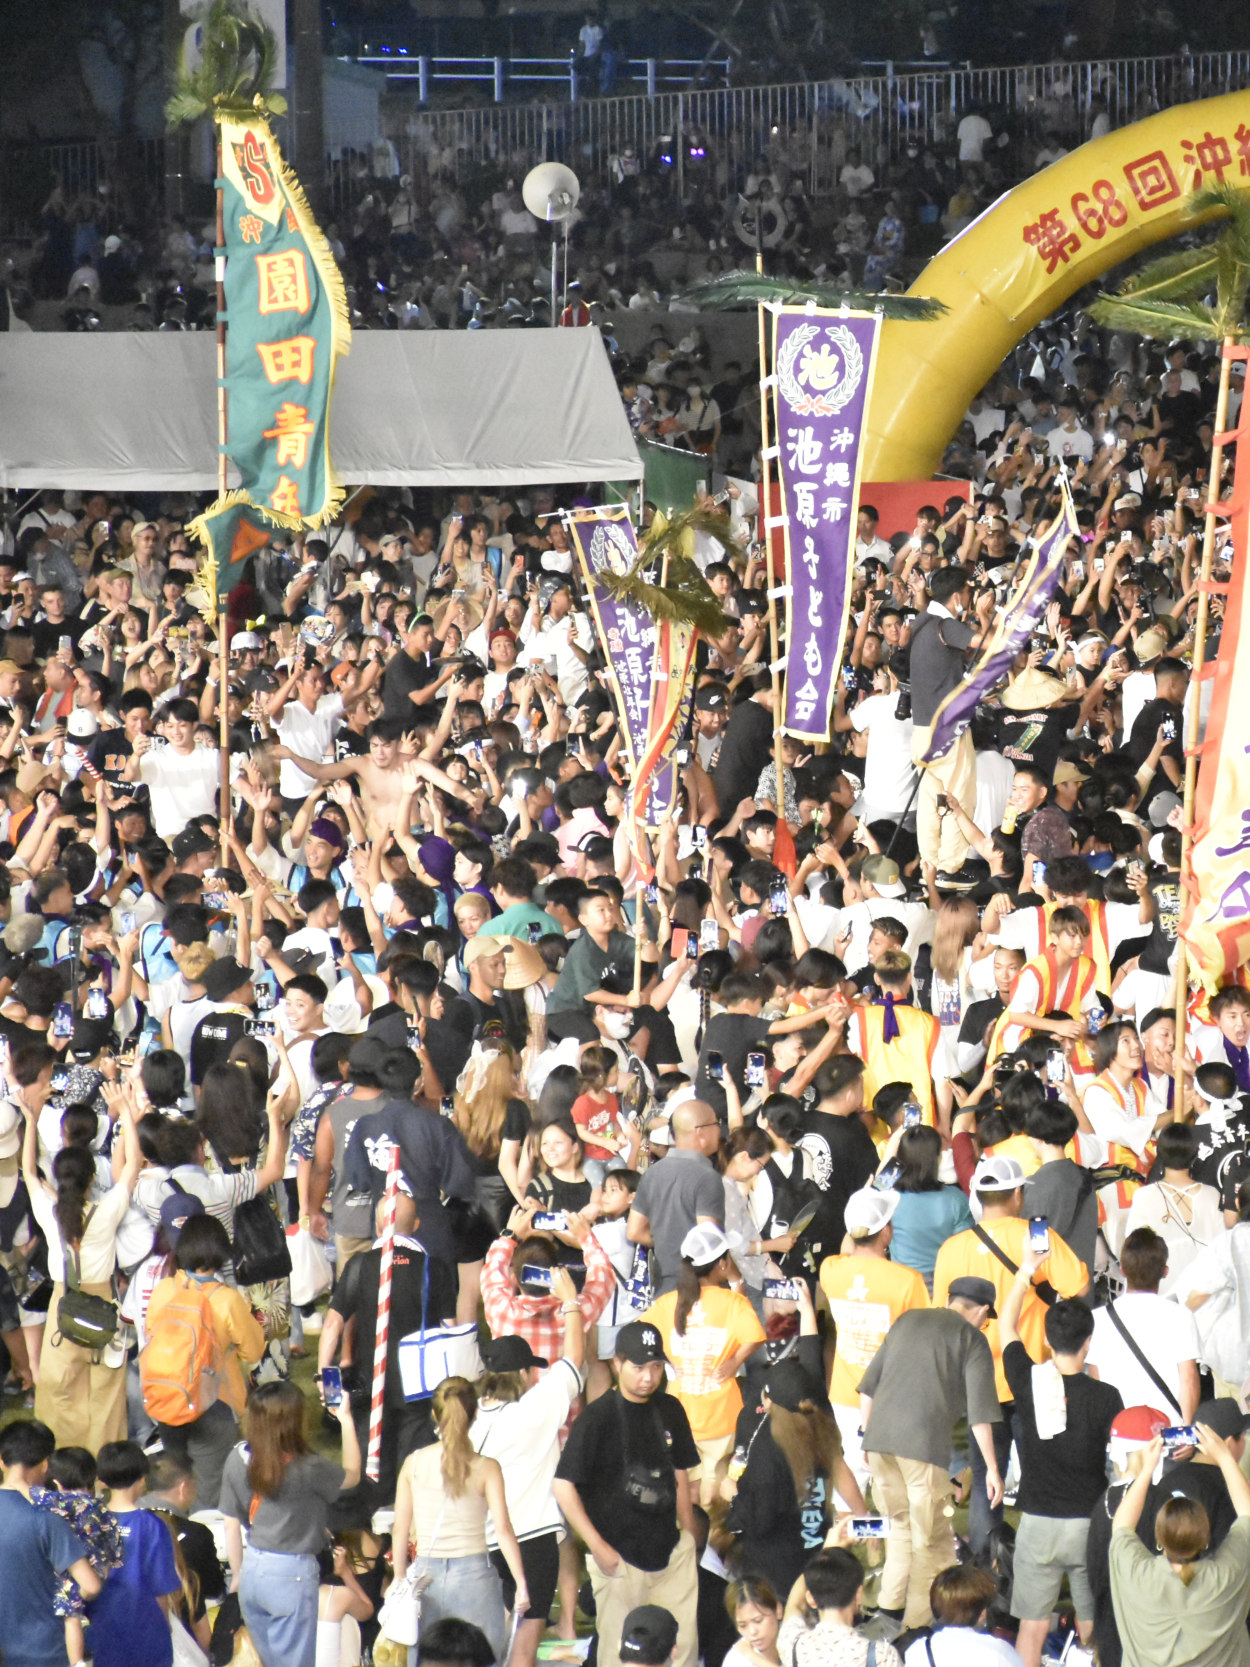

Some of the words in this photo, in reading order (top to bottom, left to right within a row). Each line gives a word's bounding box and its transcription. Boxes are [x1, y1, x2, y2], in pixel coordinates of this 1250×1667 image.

[798, 343, 840, 390] 池
[821, 426, 855, 522] 沖縄市
